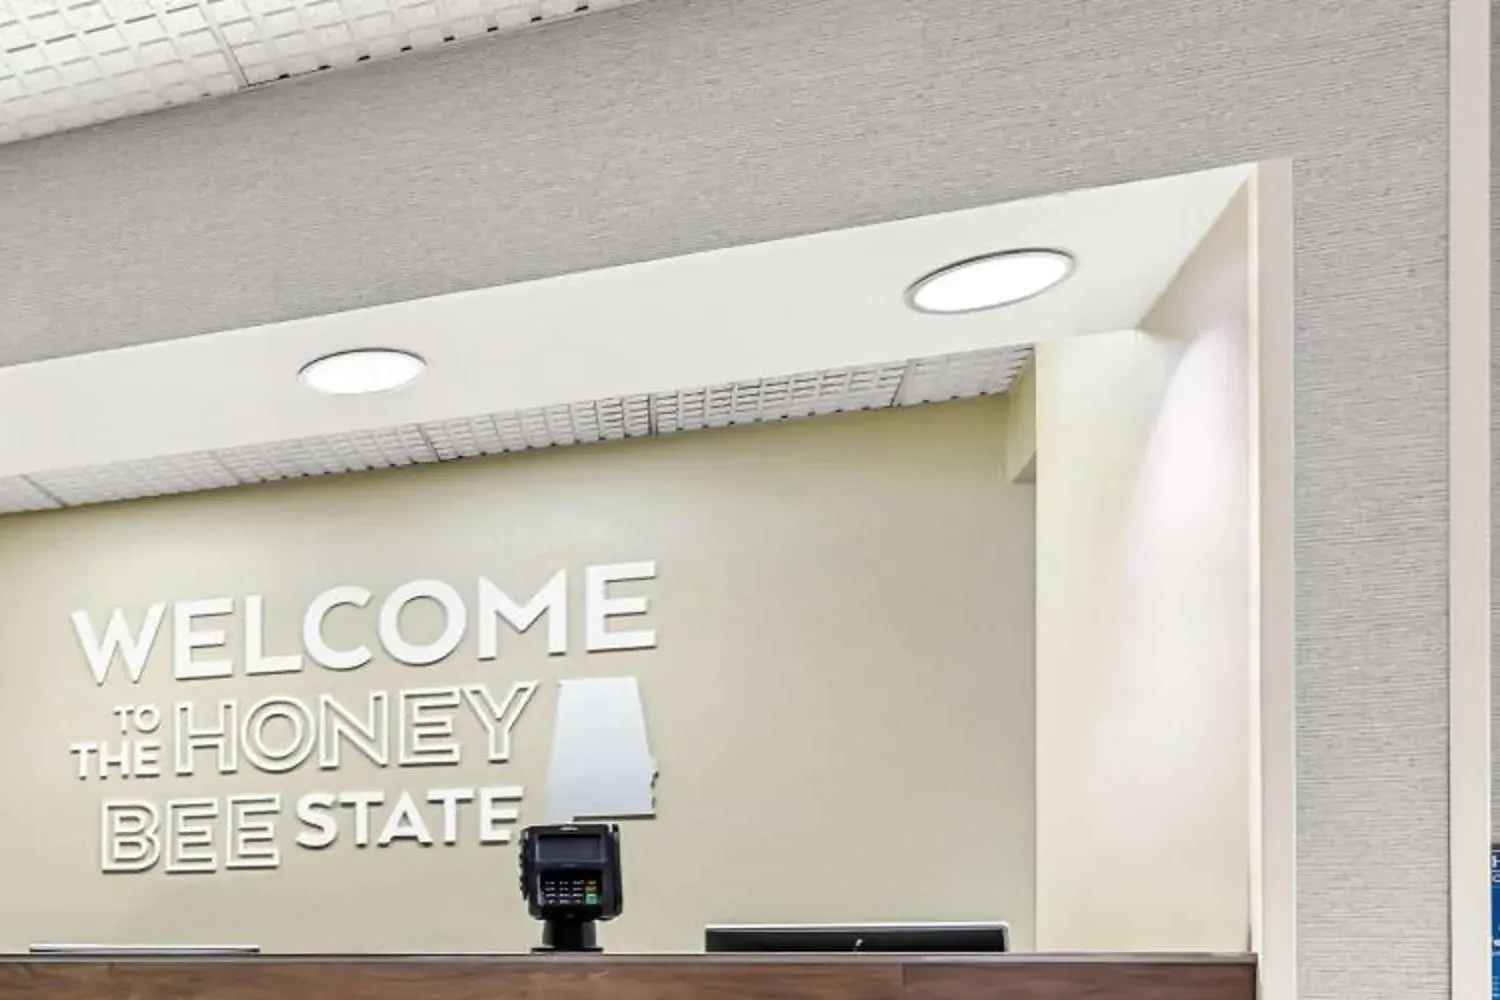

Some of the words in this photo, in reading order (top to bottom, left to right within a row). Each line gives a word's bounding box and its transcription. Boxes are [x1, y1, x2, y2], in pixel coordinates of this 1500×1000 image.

[70, 560, 657, 685] WELCOME
[70, 741, 161, 780] THE
[174, 681, 540, 776] HONEY
[112, 705, 161, 735] TO
[100, 792, 281, 875] BEE
[294, 785, 525, 847] STATE
